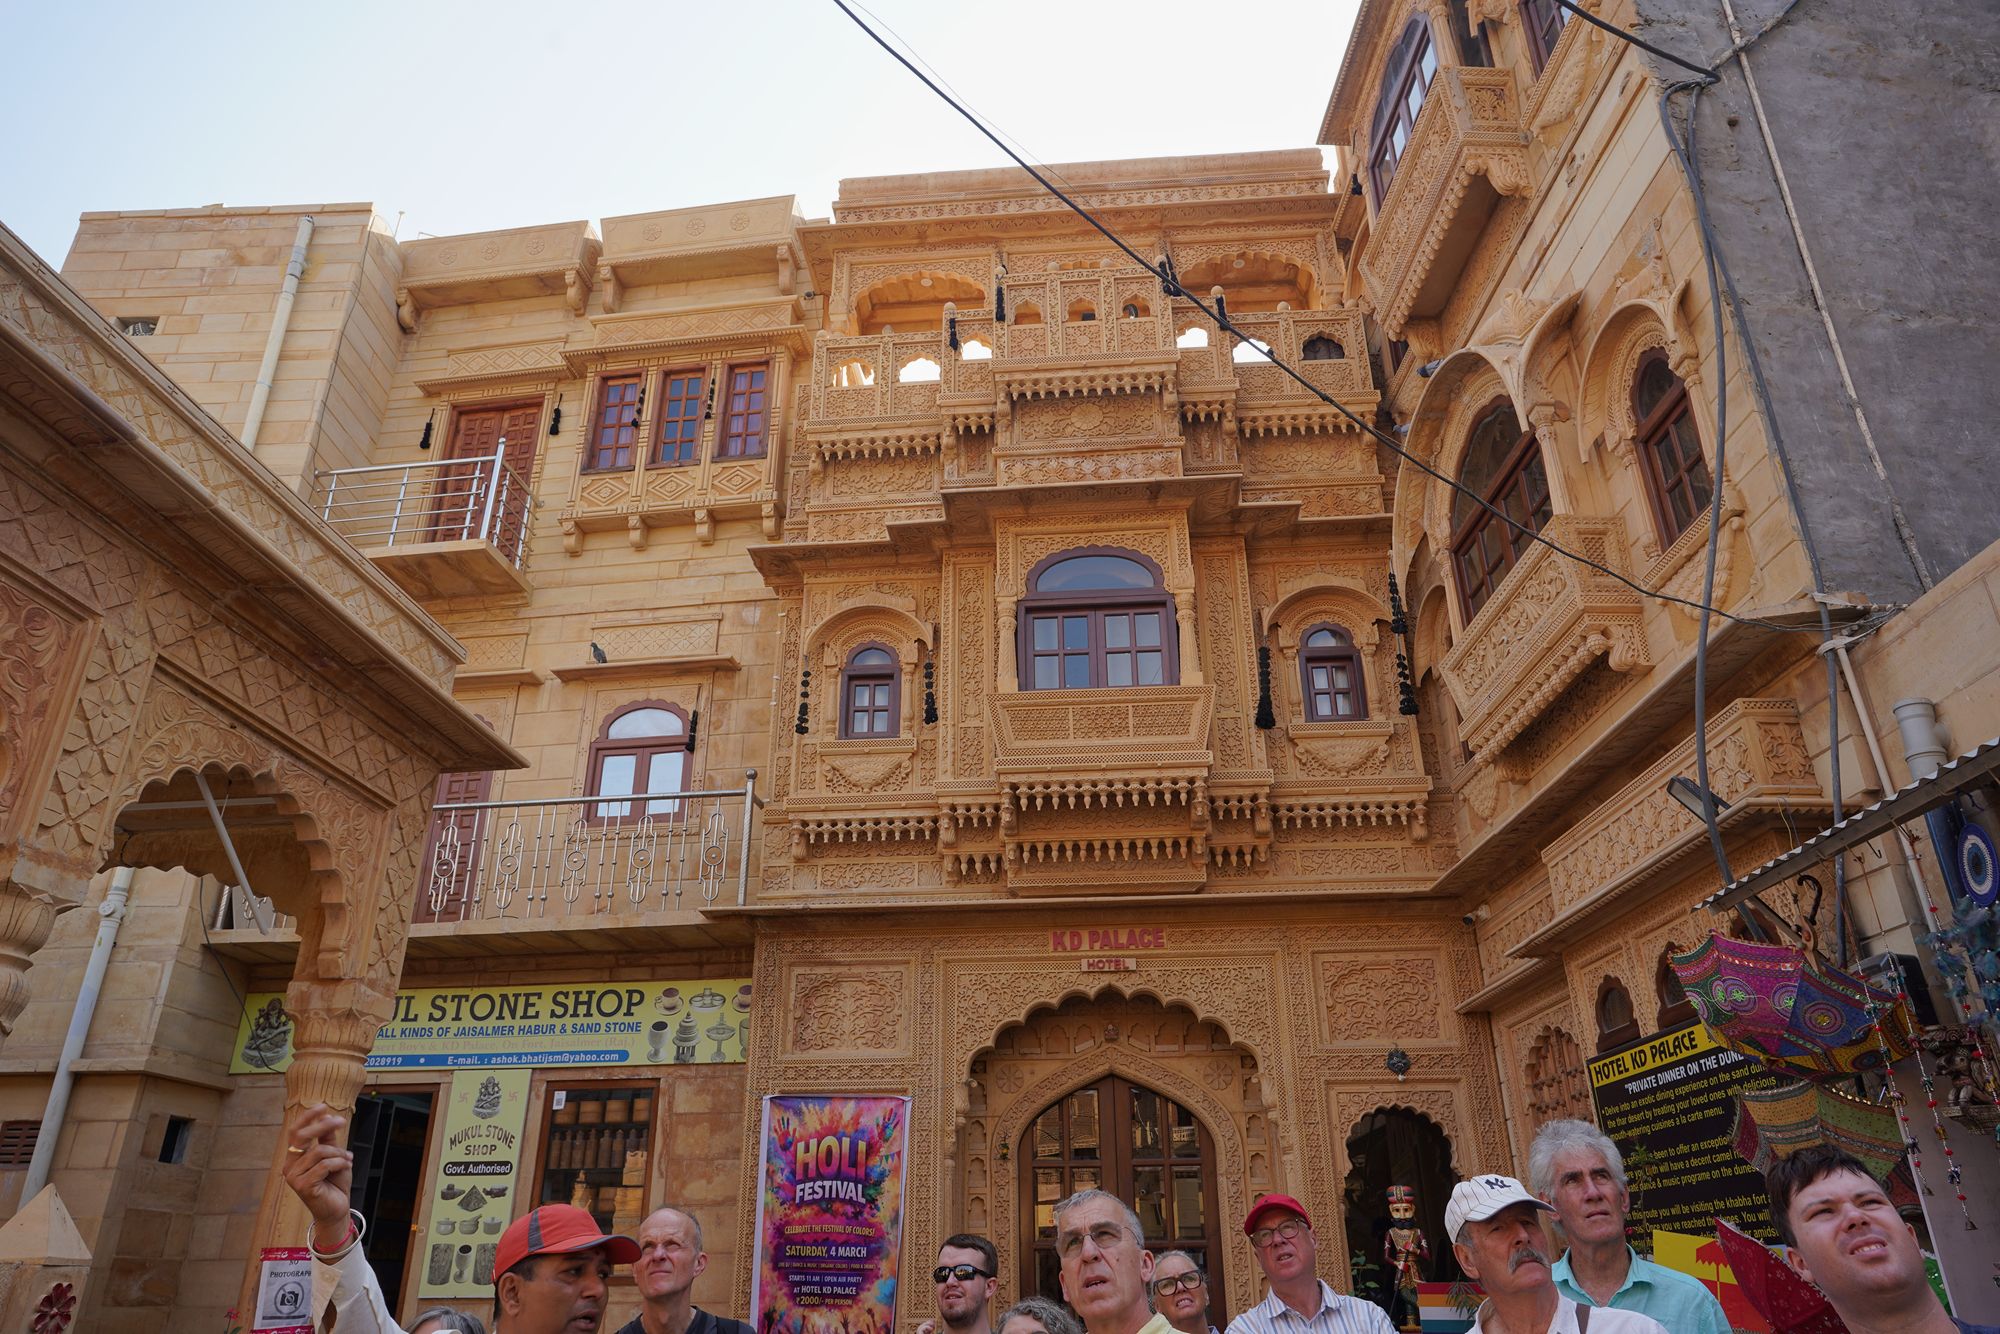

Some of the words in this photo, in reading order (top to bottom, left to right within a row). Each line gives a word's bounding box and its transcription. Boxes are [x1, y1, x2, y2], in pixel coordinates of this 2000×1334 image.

[1052, 930, 1082, 950] KD
[1088, 928, 1164, 949] PALACE
[1087, 959, 1129, 969] HOTEL
[428, 992, 542, 1022] STONE
[550, 989, 645, 1019] SHOP
[377, 1028, 396, 1038] ALL
[400, 1028, 433, 1038] KINDS
[436, 1027, 450, 1037] OF
[454, 1026, 514, 1037] JAISALMER
[518, 1024, 556, 1035] HABUR
[559, 1024, 567, 1034] &
[571, 1022, 600, 1033] SAND
[605, 1022, 641, 1032] STONE
[448, 1056, 481, 1064] E-mail.
[1593, 1056, 1629, 1085] HOTEL
[1631, 1049, 1647, 1069] KD
[1650, 1030, 1698, 1063] PALACE
[1657, 1066, 1686, 1085] DINNER
[1687, 1061, 1699, 1074] ON
[1700, 1055, 1718, 1072] THE
[1605, 1105, 1619, 1116] Delve
[1620, 1102, 1630, 1112] into
[1638, 1095, 1654, 1106] exotic
[1656, 1090, 1674, 1102] dining
[1674, 1079, 1708, 1098] experience
[1709, 1076, 1718, 1086] on
[1719, 1072, 1730, 1083] the
[1732, 1066, 1749, 1079] sand
[1607, 1119, 1616, 1128] the
[1616, 1116, 1627, 1127] thar
[1627, 1111, 1644, 1125] desert
[1645, 1110, 1652, 1120] by
[1653, 1104, 1675, 1118] treating
[1676, 1100, 1689, 1112] your
[1690, 1092, 1708, 1106] loved
[1709, 1089, 1726, 1101] ones
[1743, 1076, 1776, 1092] delicious
[1610, 1125, 1651, 1141] mouth-watering
[1651, 1119, 1675, 1131] cuisines
[1680, 1115, 1687, 1123] la
[1687, 1110, 1703, 1122] carte
[1704, 1107, 1725, 1118] menu.
[450, 1125, 482, 1150] MUKUL
[485, 1125, 515, 1149] STONE
[464, 1144, 497, 1155] SHOP
[796, 1136, 866, 1180] HOLI
[1653, 1150, 1668, 1160] been
[1669, 1148, 1675, 1156] to
[1676, 1144, 1690, 1154] offer
[1691, 1143, 1698, 1151] an
[1659, 1163, 1669, 1173] will
[1670, 1161, 1685, 1171] have
[1690, 1154, 1711, 1167] decent
[1712, 1149, 1732, 1163] camel
[446, 1164, 466, 1174] Govt.
[468, 1163, 511, 1173] Authorised
[1657, 1178, 1662, 1188] &
[1662, 1176, 1680, 1186] music
[1681, 1172, 1710, 1187] programe
[1711, 1170, 1720, 1179] on
[1721, 1166, 1732, 1176] the
[795, 1181, 866, 1204] FESTIVAL
[1632, 1210, 1642, 1220] this
[1644, 1208, 1658, 1218] route
[1659, 1208, 1669, 1219] you
[1671, 1204, 1681, 1215] will
[1681, 1204, 1689, 1214] be
[1690, 1200, 1714, 1213] visiting
[1714, 1199, 1725, 1209] the
[1726, 1196, 1752, 1209] khabha
[1752, 1194, 1767, 1205] fort
[785, 1225, 811, 1234] CELEBRATE
[823, 1225, 844, 1233] FESTIVAL
[845, 1225, 852, 1233] OF
[853, 1226, 875, 1236] COLORS!
[1645, 1222, 1660, 1233] Once
[1662, 1221, 1672, 1232] you
[1682, 1217, 1706, 1229] reached
[1742, 1211, 1757, 1222] You
[1758, 1208, 1770, 1219] will
[786, 1245, 827, 1258] SATURDAY,
[830, 1246, 836, 1256] 4
[838, 1246, 867, 1257] MARCH
[801, 1286, 821, 1294] HOTEL
[833, 1287, 856, 1295] PALACE
